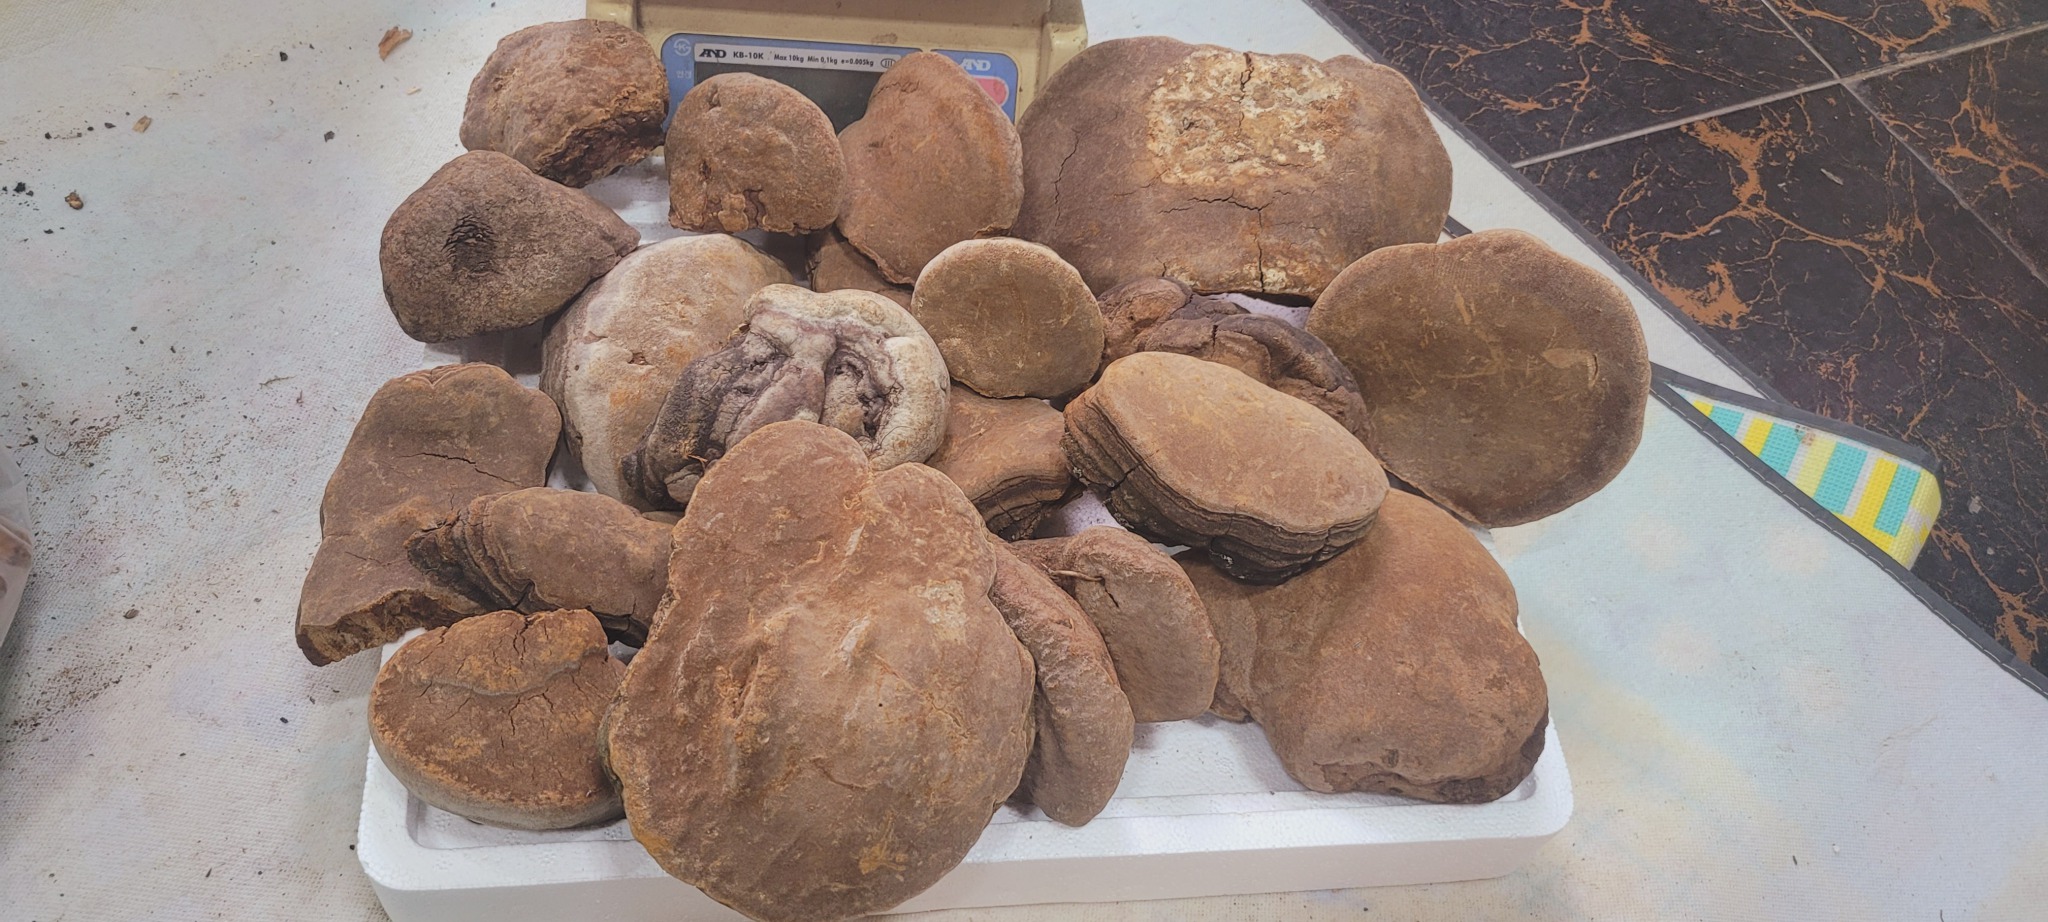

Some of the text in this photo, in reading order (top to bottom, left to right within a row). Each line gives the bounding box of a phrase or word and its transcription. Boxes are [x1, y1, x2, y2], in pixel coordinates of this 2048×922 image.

[733, 51, 764, 60] KB-10K
[774, 53, 787, 61] Max
[789, 54, 804, 63] 10kg
[807, 55, 819, 63] Min
